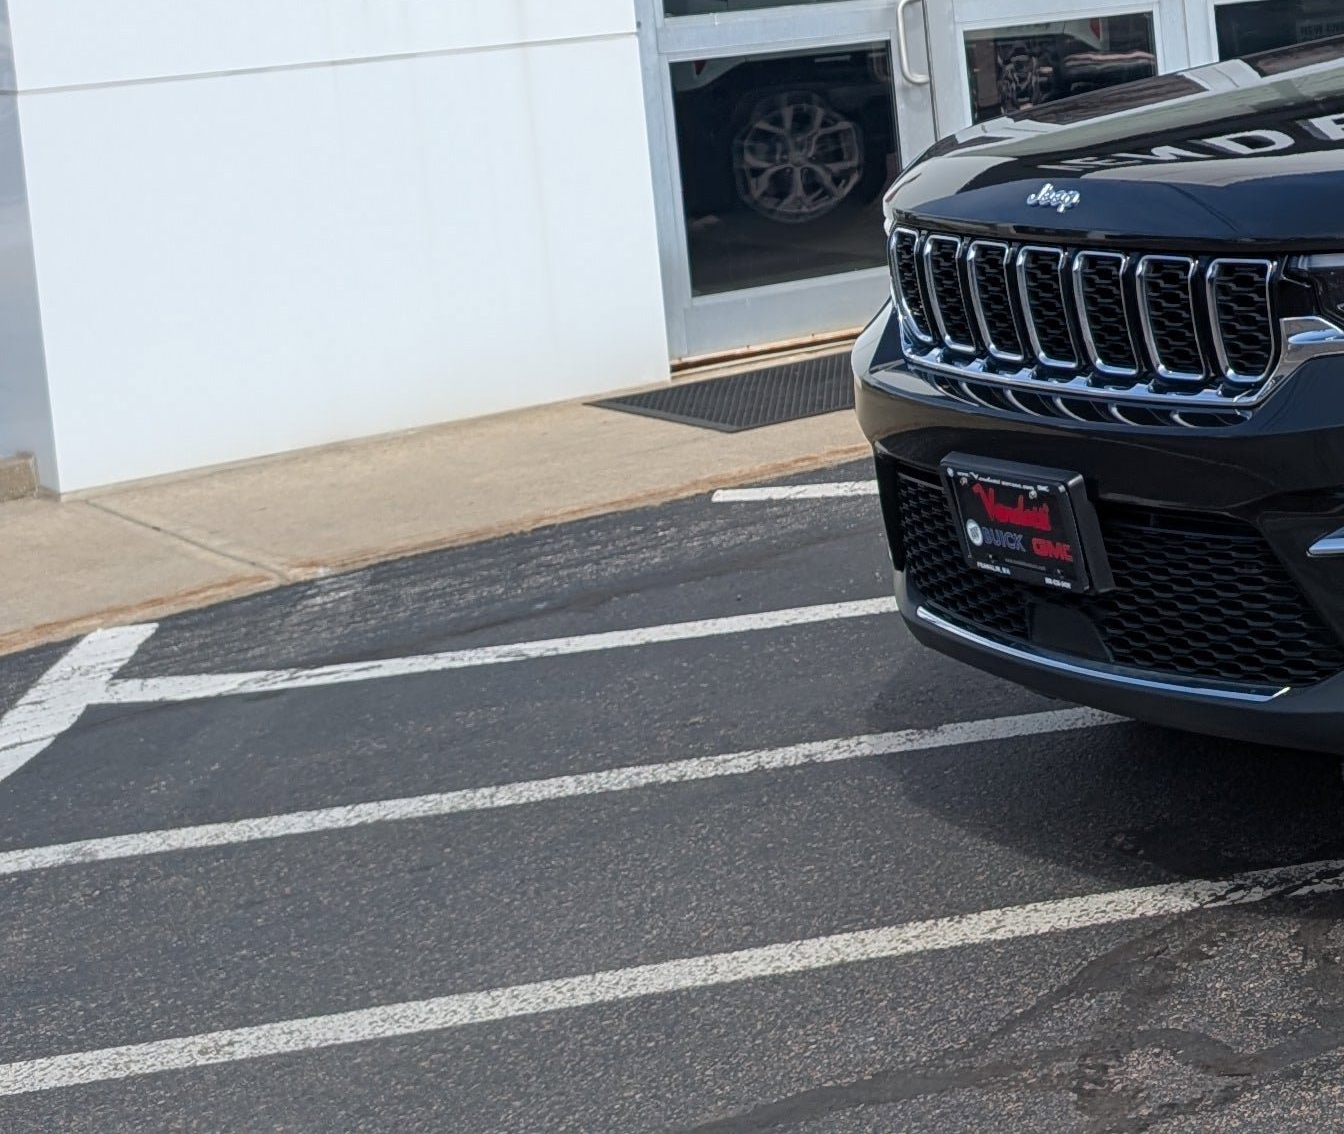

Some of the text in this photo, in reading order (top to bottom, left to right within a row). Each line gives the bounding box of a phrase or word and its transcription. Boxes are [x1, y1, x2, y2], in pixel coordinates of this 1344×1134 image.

[1026, 182, 1081, 214] Jeep
[981, 526, 1074, 563] BUICK GMC
